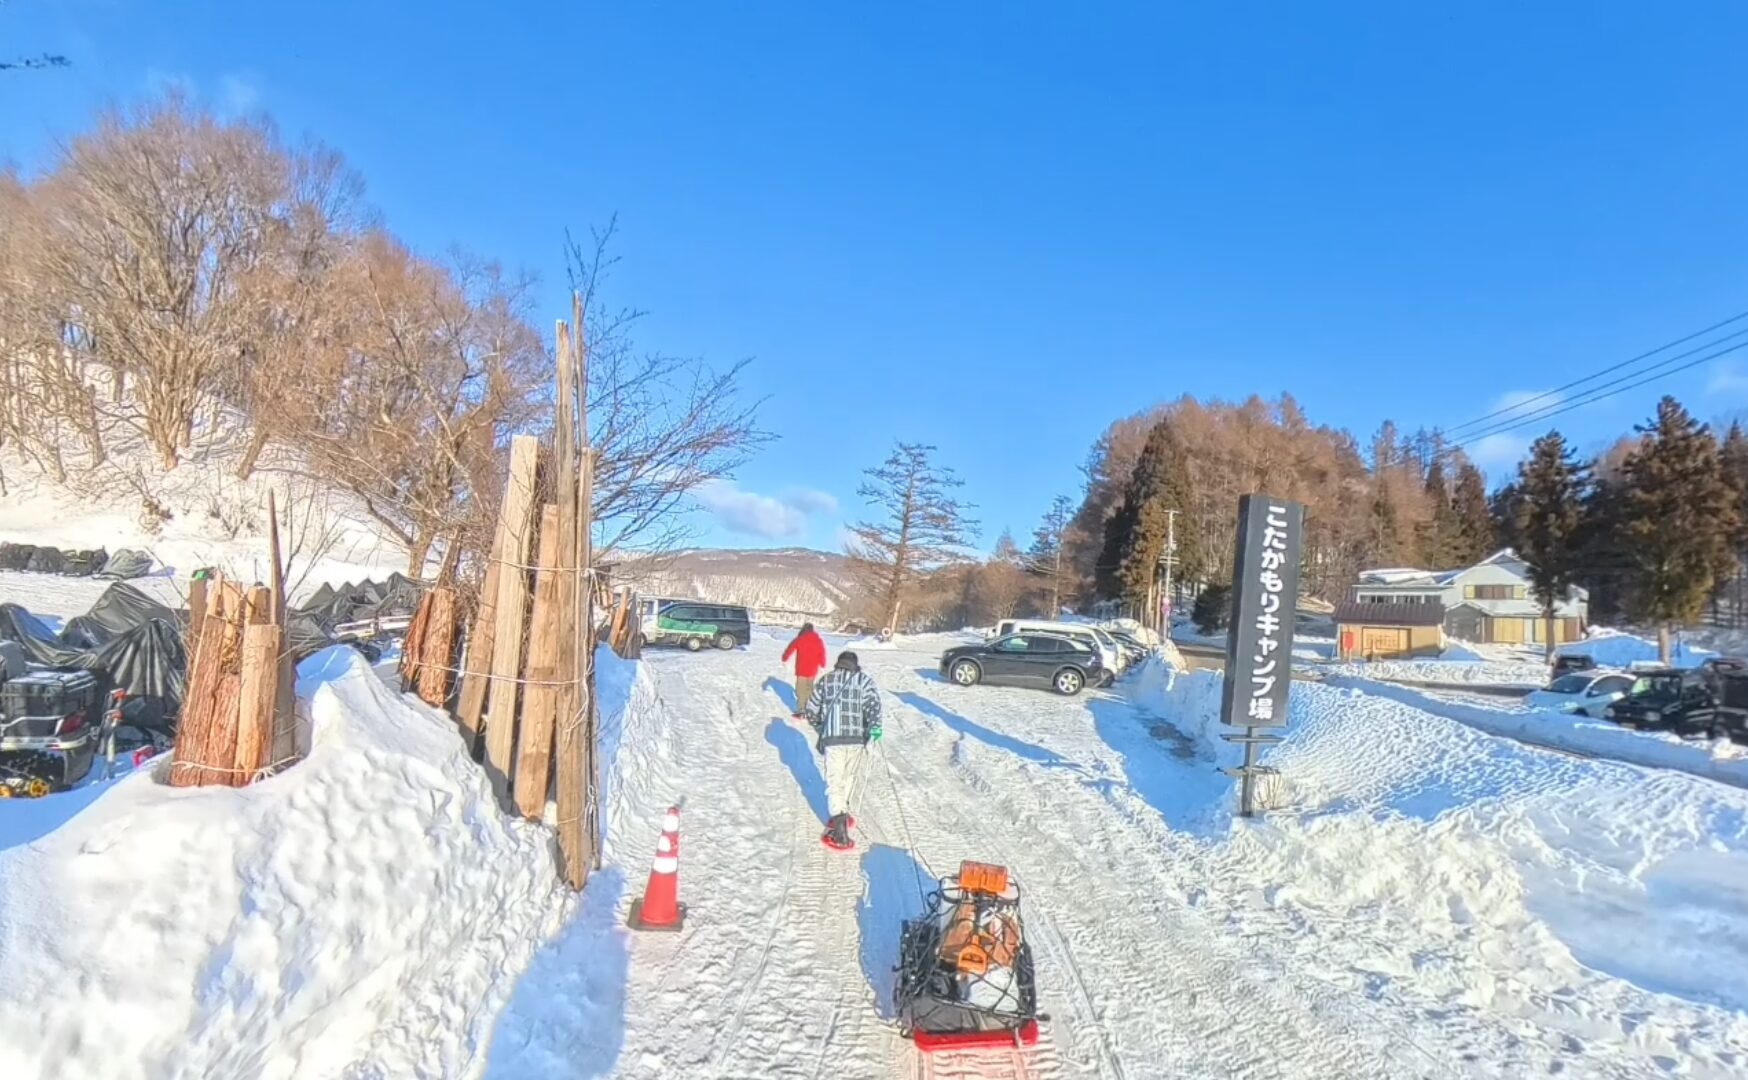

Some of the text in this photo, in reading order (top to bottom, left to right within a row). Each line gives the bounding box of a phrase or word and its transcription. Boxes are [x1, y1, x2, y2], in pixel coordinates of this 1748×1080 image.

[1249, 506, 1287, 719] こたかもりキャンプ場
